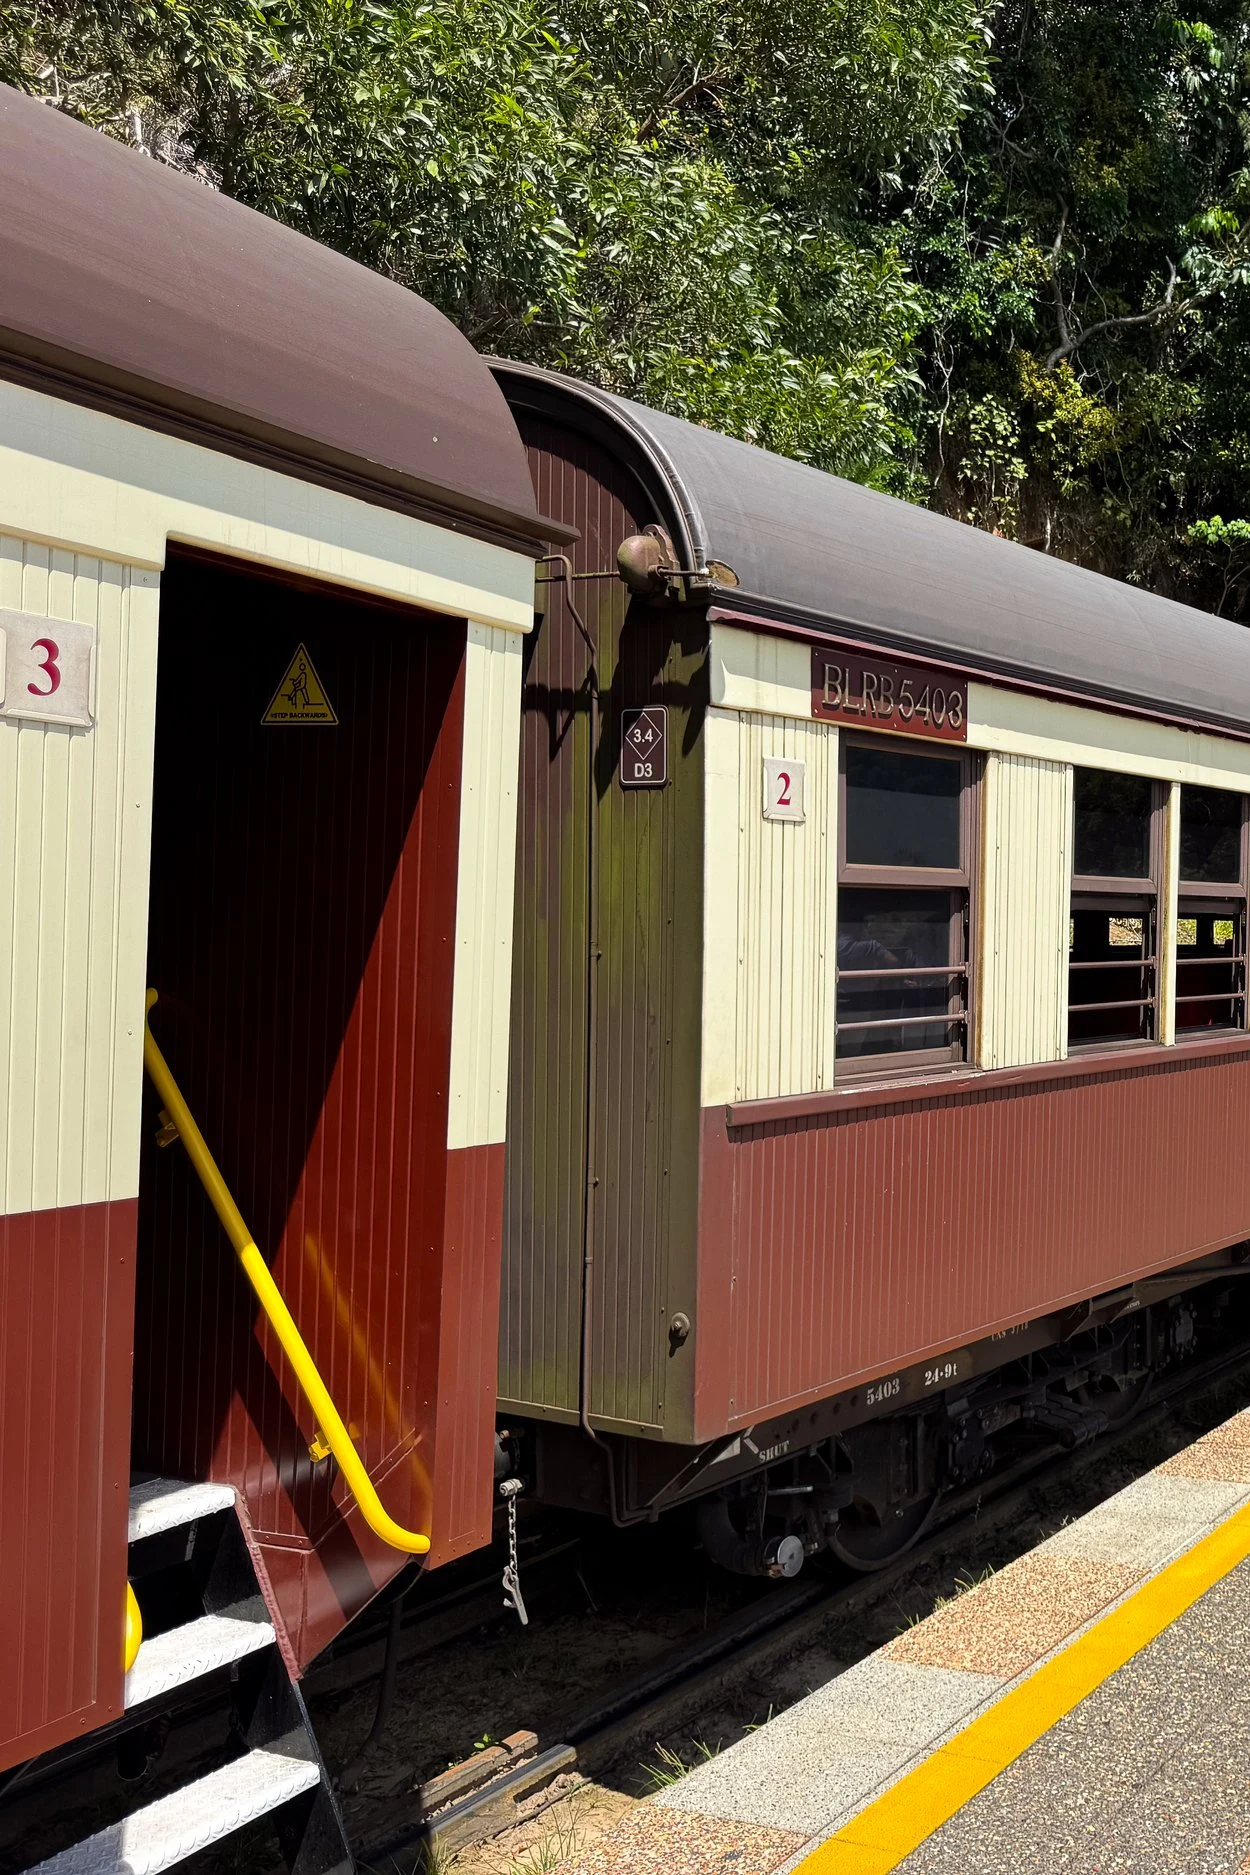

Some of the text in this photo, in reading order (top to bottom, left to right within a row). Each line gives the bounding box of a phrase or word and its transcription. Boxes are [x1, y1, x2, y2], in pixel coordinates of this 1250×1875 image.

[27, 637, 61, 697] 3
[633, 728, 654, 744] 3.4
[634, 763, 653, 778] D3
[776, 772, 792, 806] 2
[866, 1377, 901, 1405] 5403
[758, 1440, 790, 1463] SHUT
